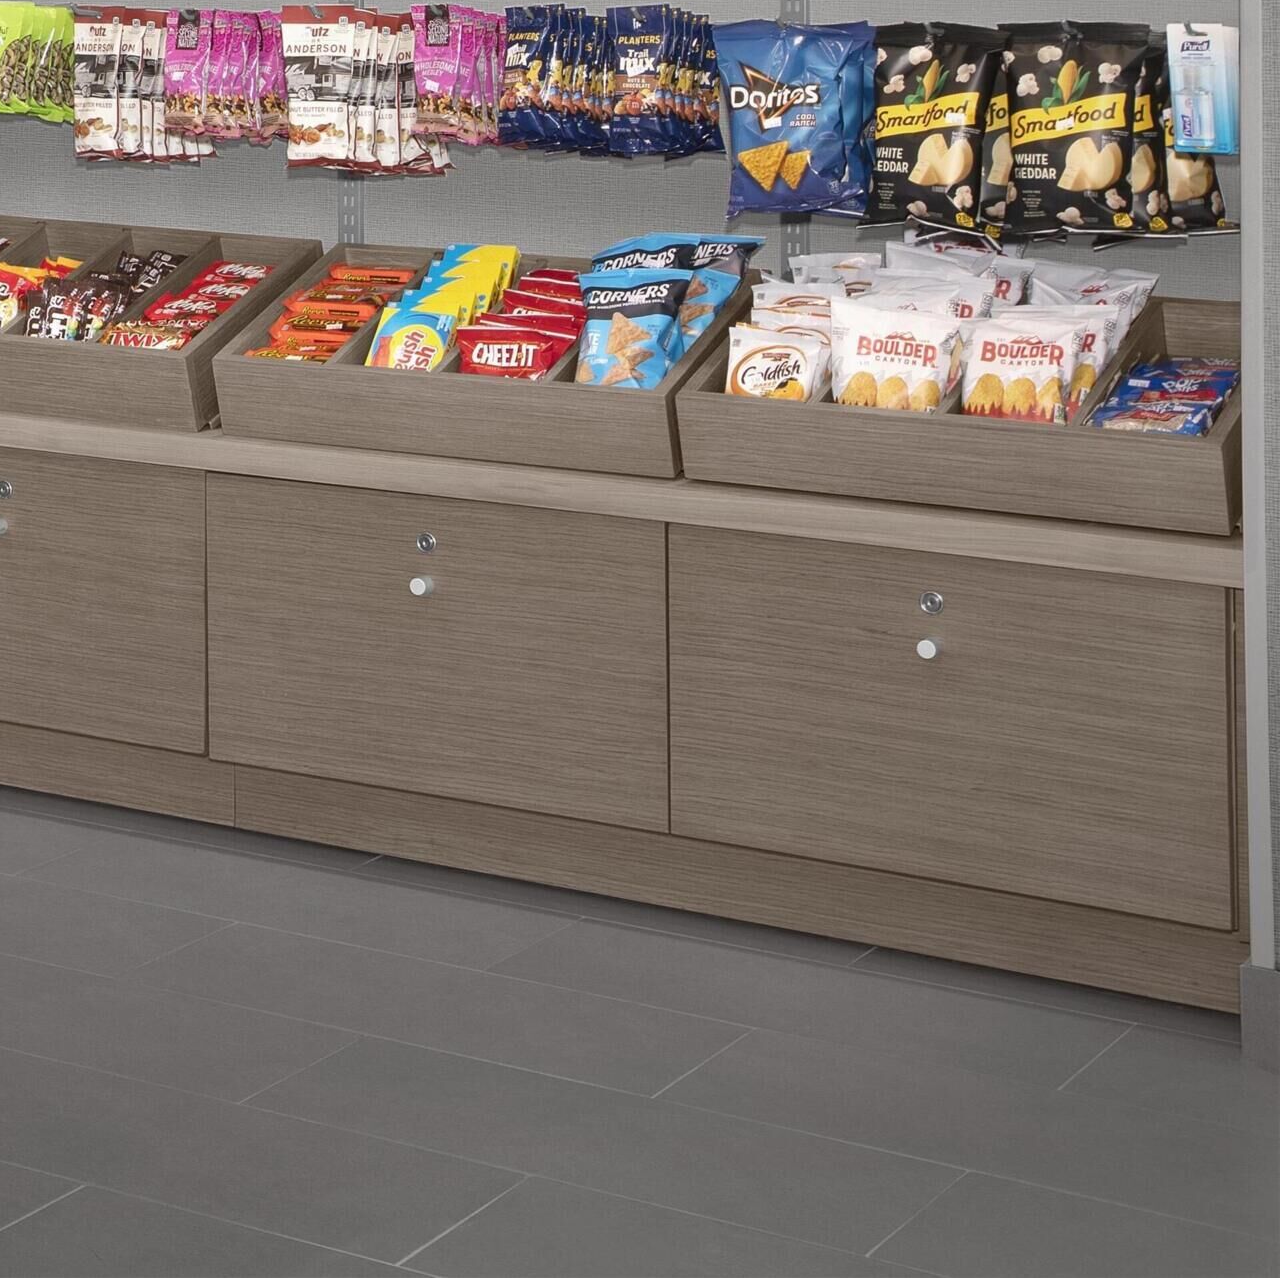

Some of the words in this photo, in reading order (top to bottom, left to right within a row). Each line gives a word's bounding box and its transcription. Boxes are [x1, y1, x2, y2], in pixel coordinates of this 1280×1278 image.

[428, 25, 448, 34] SECOND
[509, 33, 539, 41] PLANTERS
[619, 35, 660, 44] PLANTERS
[76, 44, 114, 52] ANDERSON
[286, 44, 346, 53] ANDERSON
[627, 49, 648, 58] Trail
[416, 61, 455, 73] WHOLESOME
[619, 57, 655, 70] mix
[730, 84, 819, 108] Doritos
[876, 102, 968, 132] Smartfood
[1014, 102, 1116, 139] Smartfood
[877, 160, 908, 172] EDDAR
[1015, 154, 1048, 166] WHITE
[588, 284, 670, 305] CORNERS
[111, 332, 167, 346] TWIX
[856, 336, 938, 368] BOULDER
[981, 341, 1064, 367] BOULDER
[876, 355, 917, 366] CANYON
[741, 360, 801, 385] Gldfish
